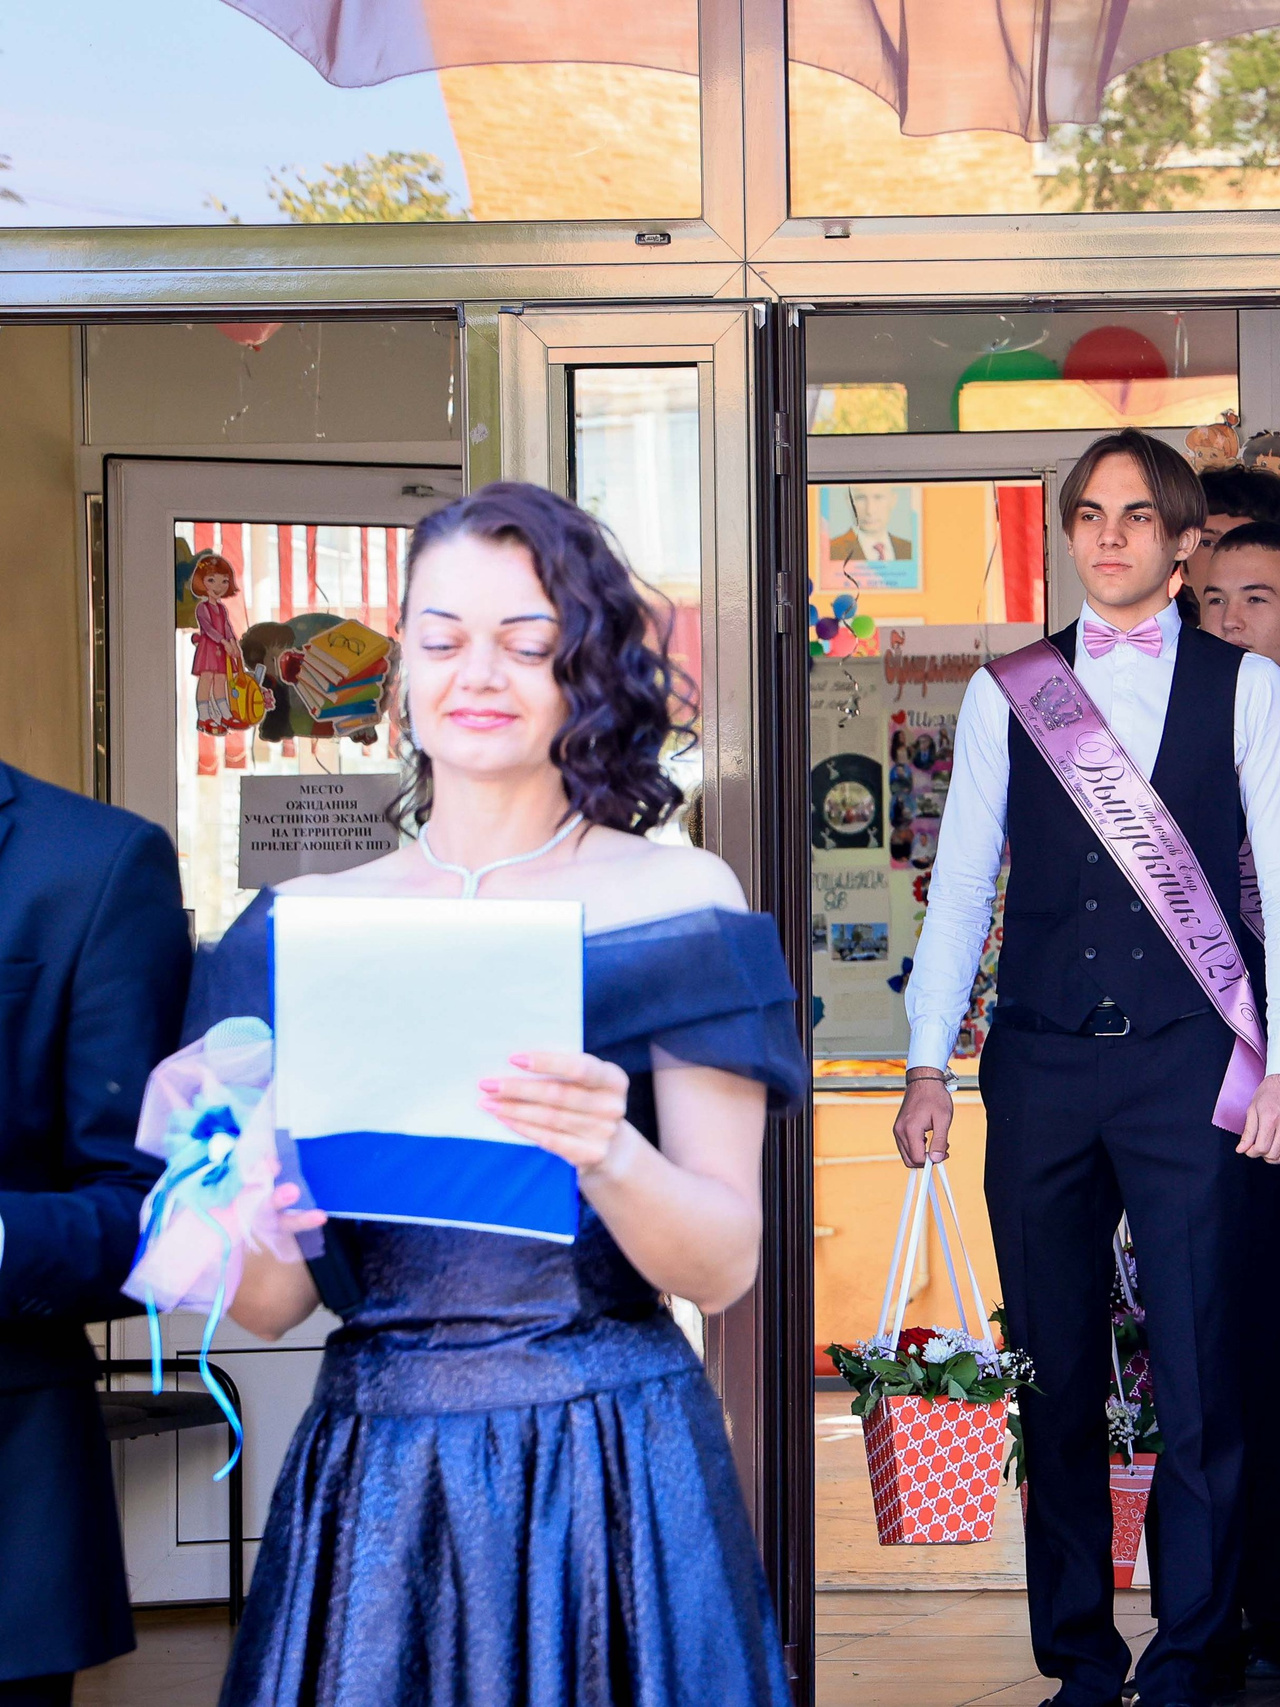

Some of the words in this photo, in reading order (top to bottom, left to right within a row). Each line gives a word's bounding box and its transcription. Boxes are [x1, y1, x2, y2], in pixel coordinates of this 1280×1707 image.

[299, 784, 344, 795] МЕСТО
[286, 800, 359, 811] ОЖИДАНИЯ
[245, 814, 330, 825] УЧАСТНИКОВ
[271, 827, 289, 838] НА
[293, 827, 372, 838] ТЕРРИТОРИИ
[251, 840, 351, 853] ПРИЛЕГАЮЩЕЙ
[354, 841, 363, 851] К
[366, 840, 391, 850] ППЭ
[1066, 731, 1202, 929] Выпускник
[1187, 924, 1244, 993] 2024
[1176, 859, 1199, 893] Егор
